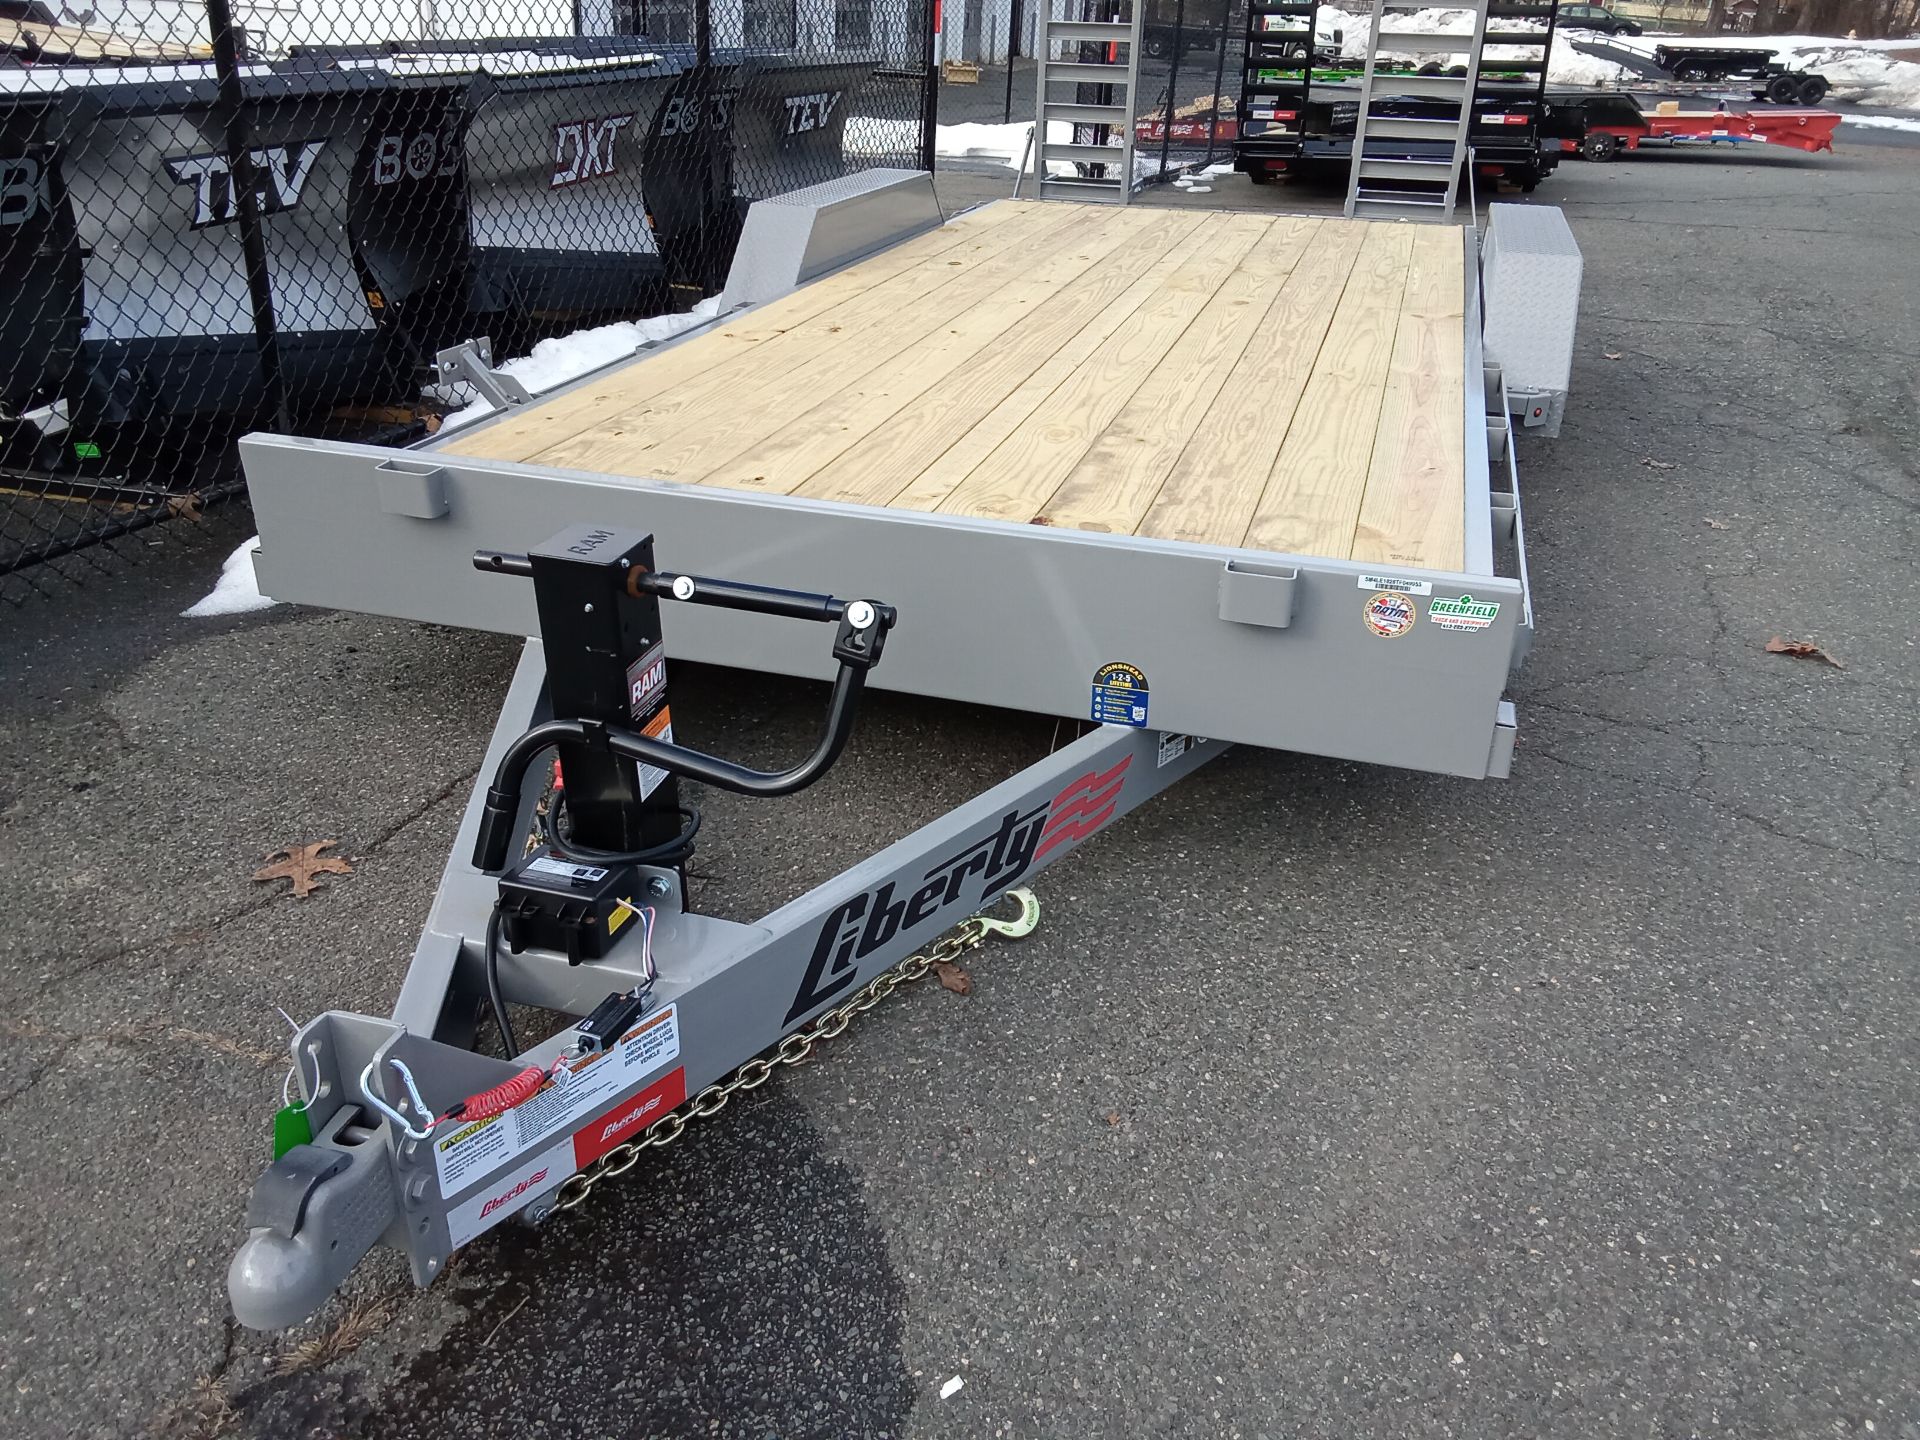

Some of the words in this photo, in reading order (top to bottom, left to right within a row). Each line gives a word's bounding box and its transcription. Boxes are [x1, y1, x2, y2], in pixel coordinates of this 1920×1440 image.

[786, 91, 841, 134] TEV
[550, 114, 635, 188] DXT
[567, 530, 615, 555] RAM
[1430, 601, 1498, 617] GREENFIELD
[632, 661, 662, 704] RAM
[1100, 663, 1144, 680] LIONSHEAD
[1112, 673, 1131, 682] 1-2-5
[782, 801, 1051, 1028] Liberty
[624, 1045, 642, 1059] CHECK
[643, 1036, 659, 1050] WHEEL
[660, 1027, 673, 1041] LUGS
[624, 1053, 643, 1067] BEFORE
[644, 1041, 663, 1057] MOVING
[664, 1034, 675, 1047] THIS
[640, 1050, 660, 1064] VEHICLE
[600, 1107, 644, 1142] Liberty
[479, 1177, 528, 1220] Liberty
